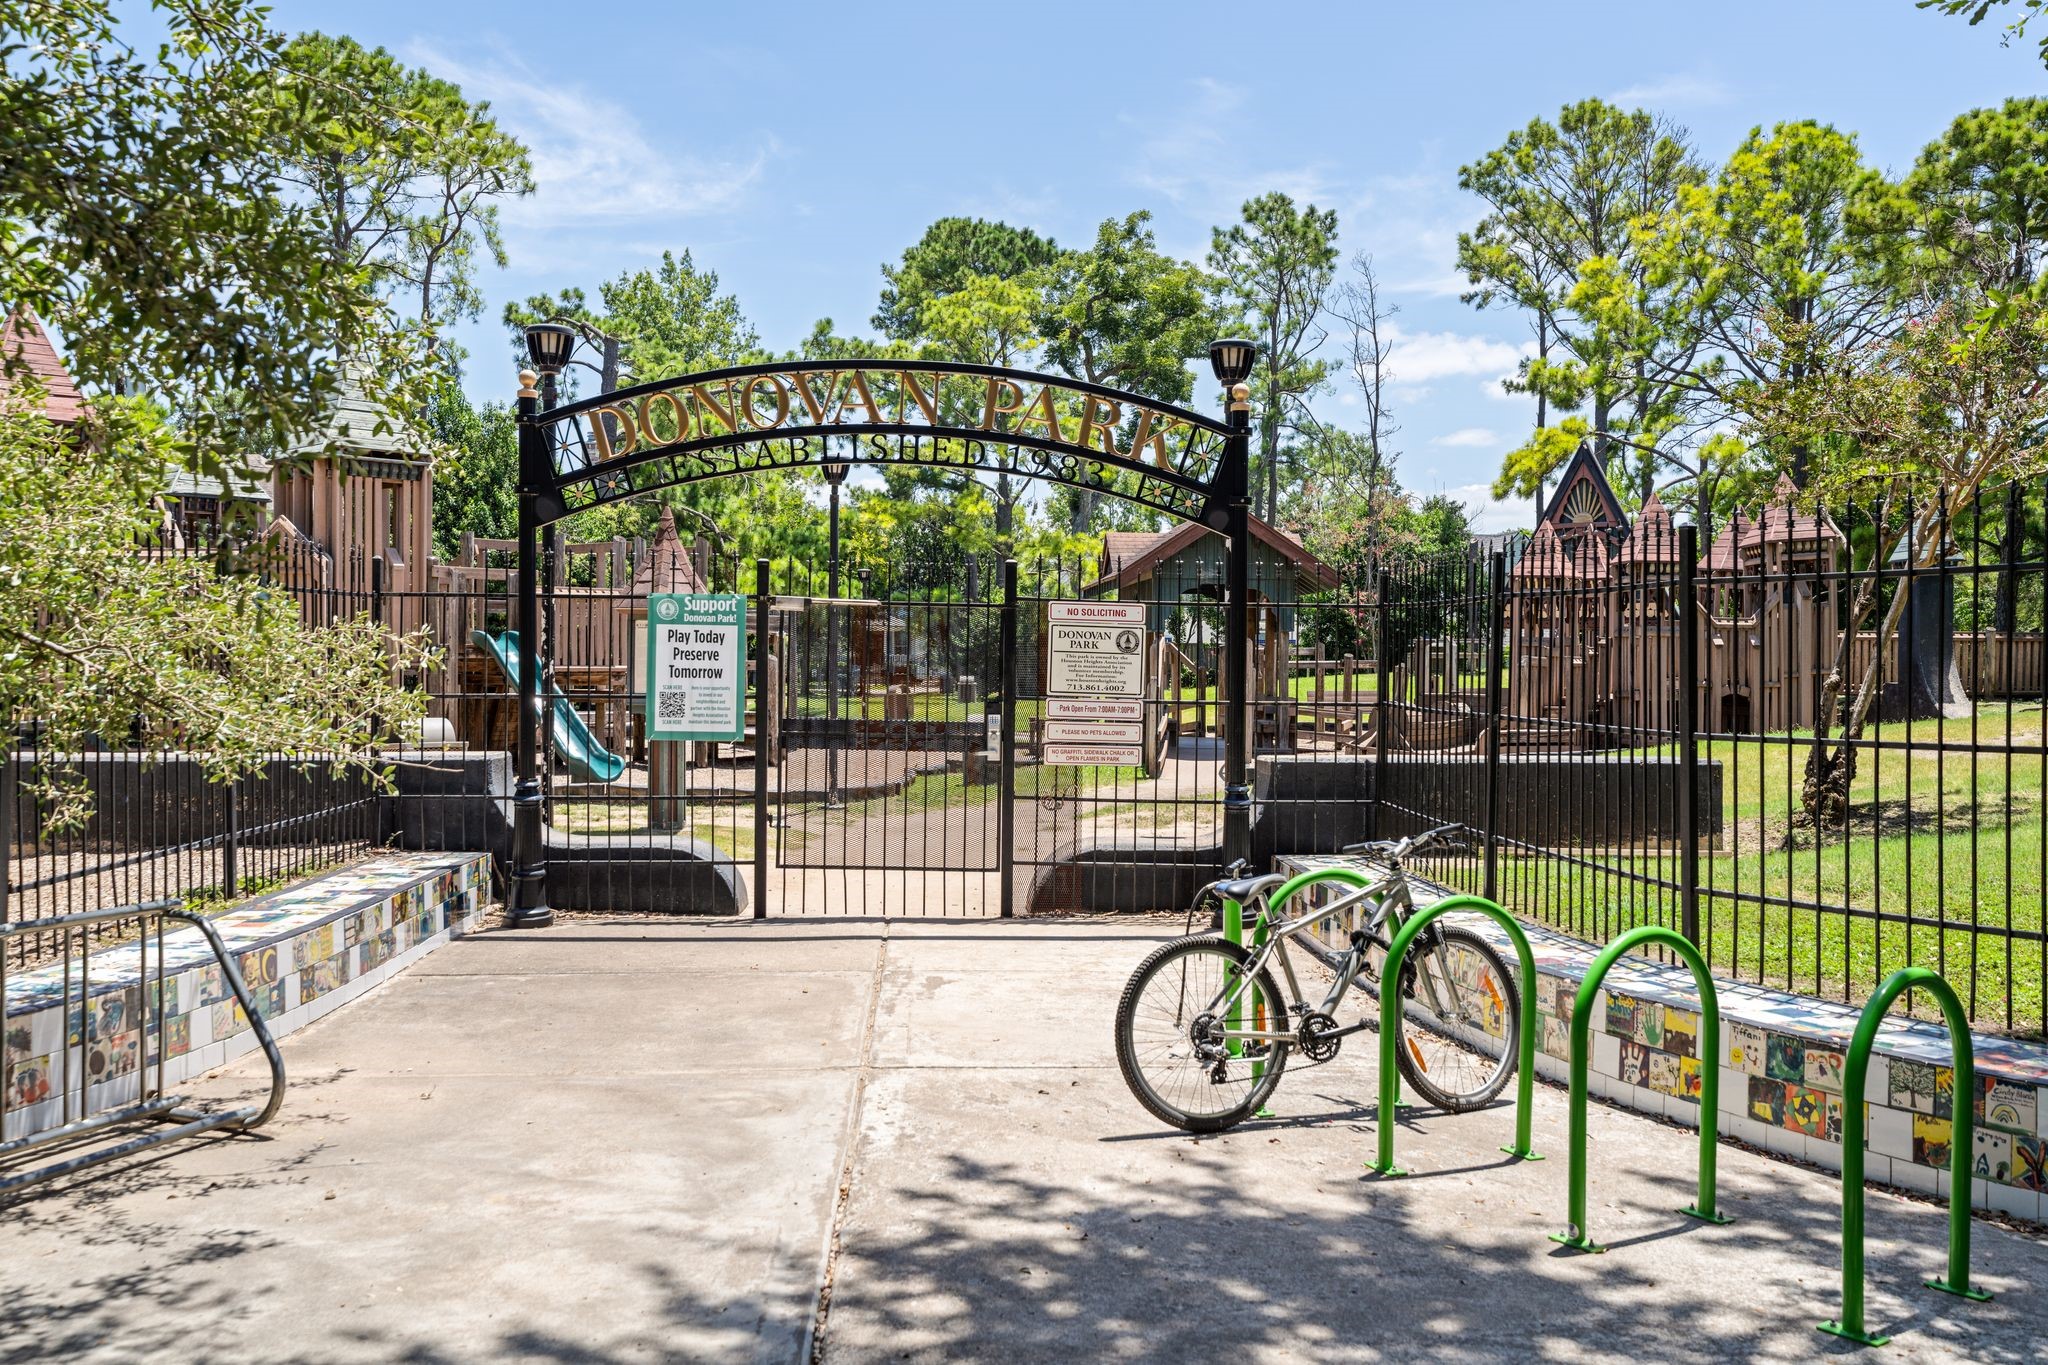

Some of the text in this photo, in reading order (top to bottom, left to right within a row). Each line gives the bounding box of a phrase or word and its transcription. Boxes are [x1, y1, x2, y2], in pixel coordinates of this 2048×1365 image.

[581, 370, 1193, 474] DONOVAN PARK
[668, 434, 1106, 488] ESTABLISHED 1983
[684, 597, 737, 613] Support
[684, 613, 737, 623] Donovan Park!
[1067, 608, 1127, 617] NO SOLICITING
[668, 629, 725, 646] Play Today
[1058, 630, 1112, 640] DONOVAN
[1070, 640, 1100, 649] PARK
[673, 647, 720, 661] Preserve
[668, 664, 723, 679] Tomorrow
[1071, 704, 1084, 713] Open
[1098, 706, 1135, 714] 7:00AM-7:00PM
[1732, 1025, 1761, 1040] Tiffani
